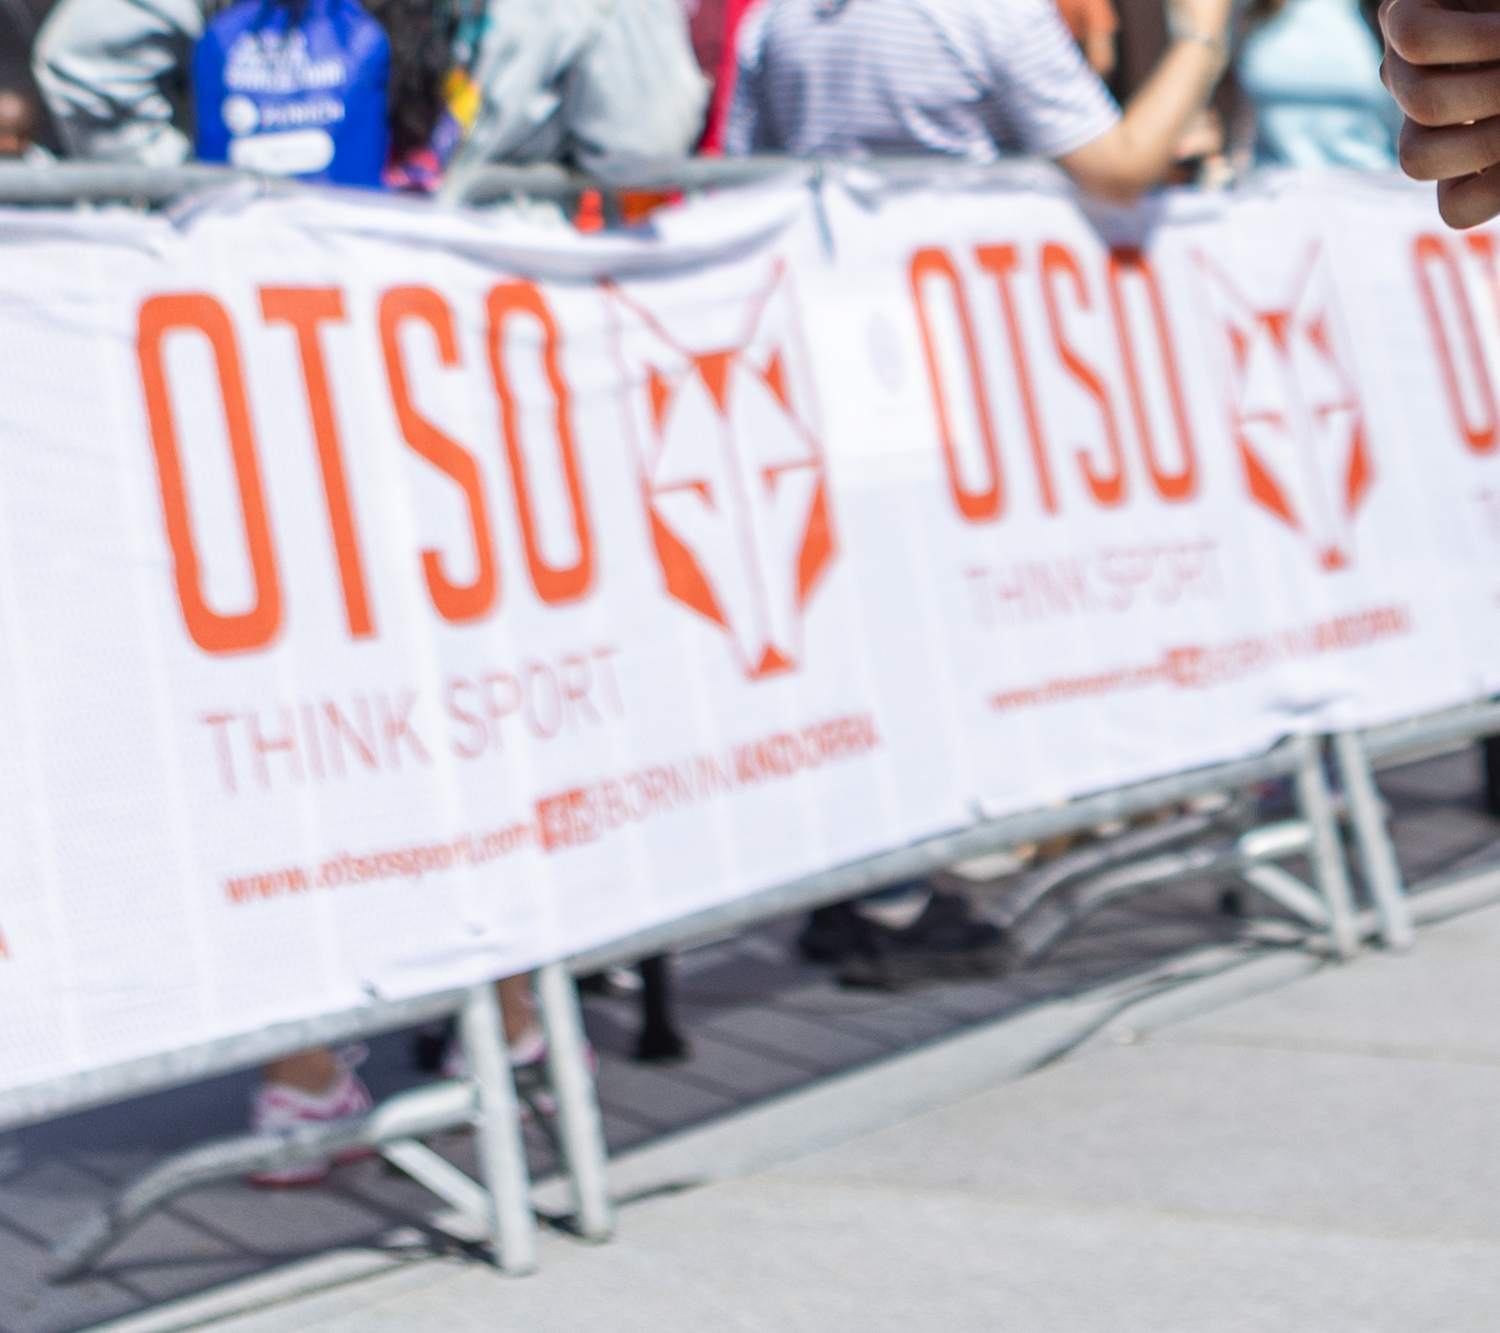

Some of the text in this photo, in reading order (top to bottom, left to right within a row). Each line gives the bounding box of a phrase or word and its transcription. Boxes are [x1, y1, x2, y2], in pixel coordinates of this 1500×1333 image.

[135, 279, 600, 658] OTSO
[906, 239, 1200, 527] OTSO
[198, 646, 626, 794] THINK SPORT
